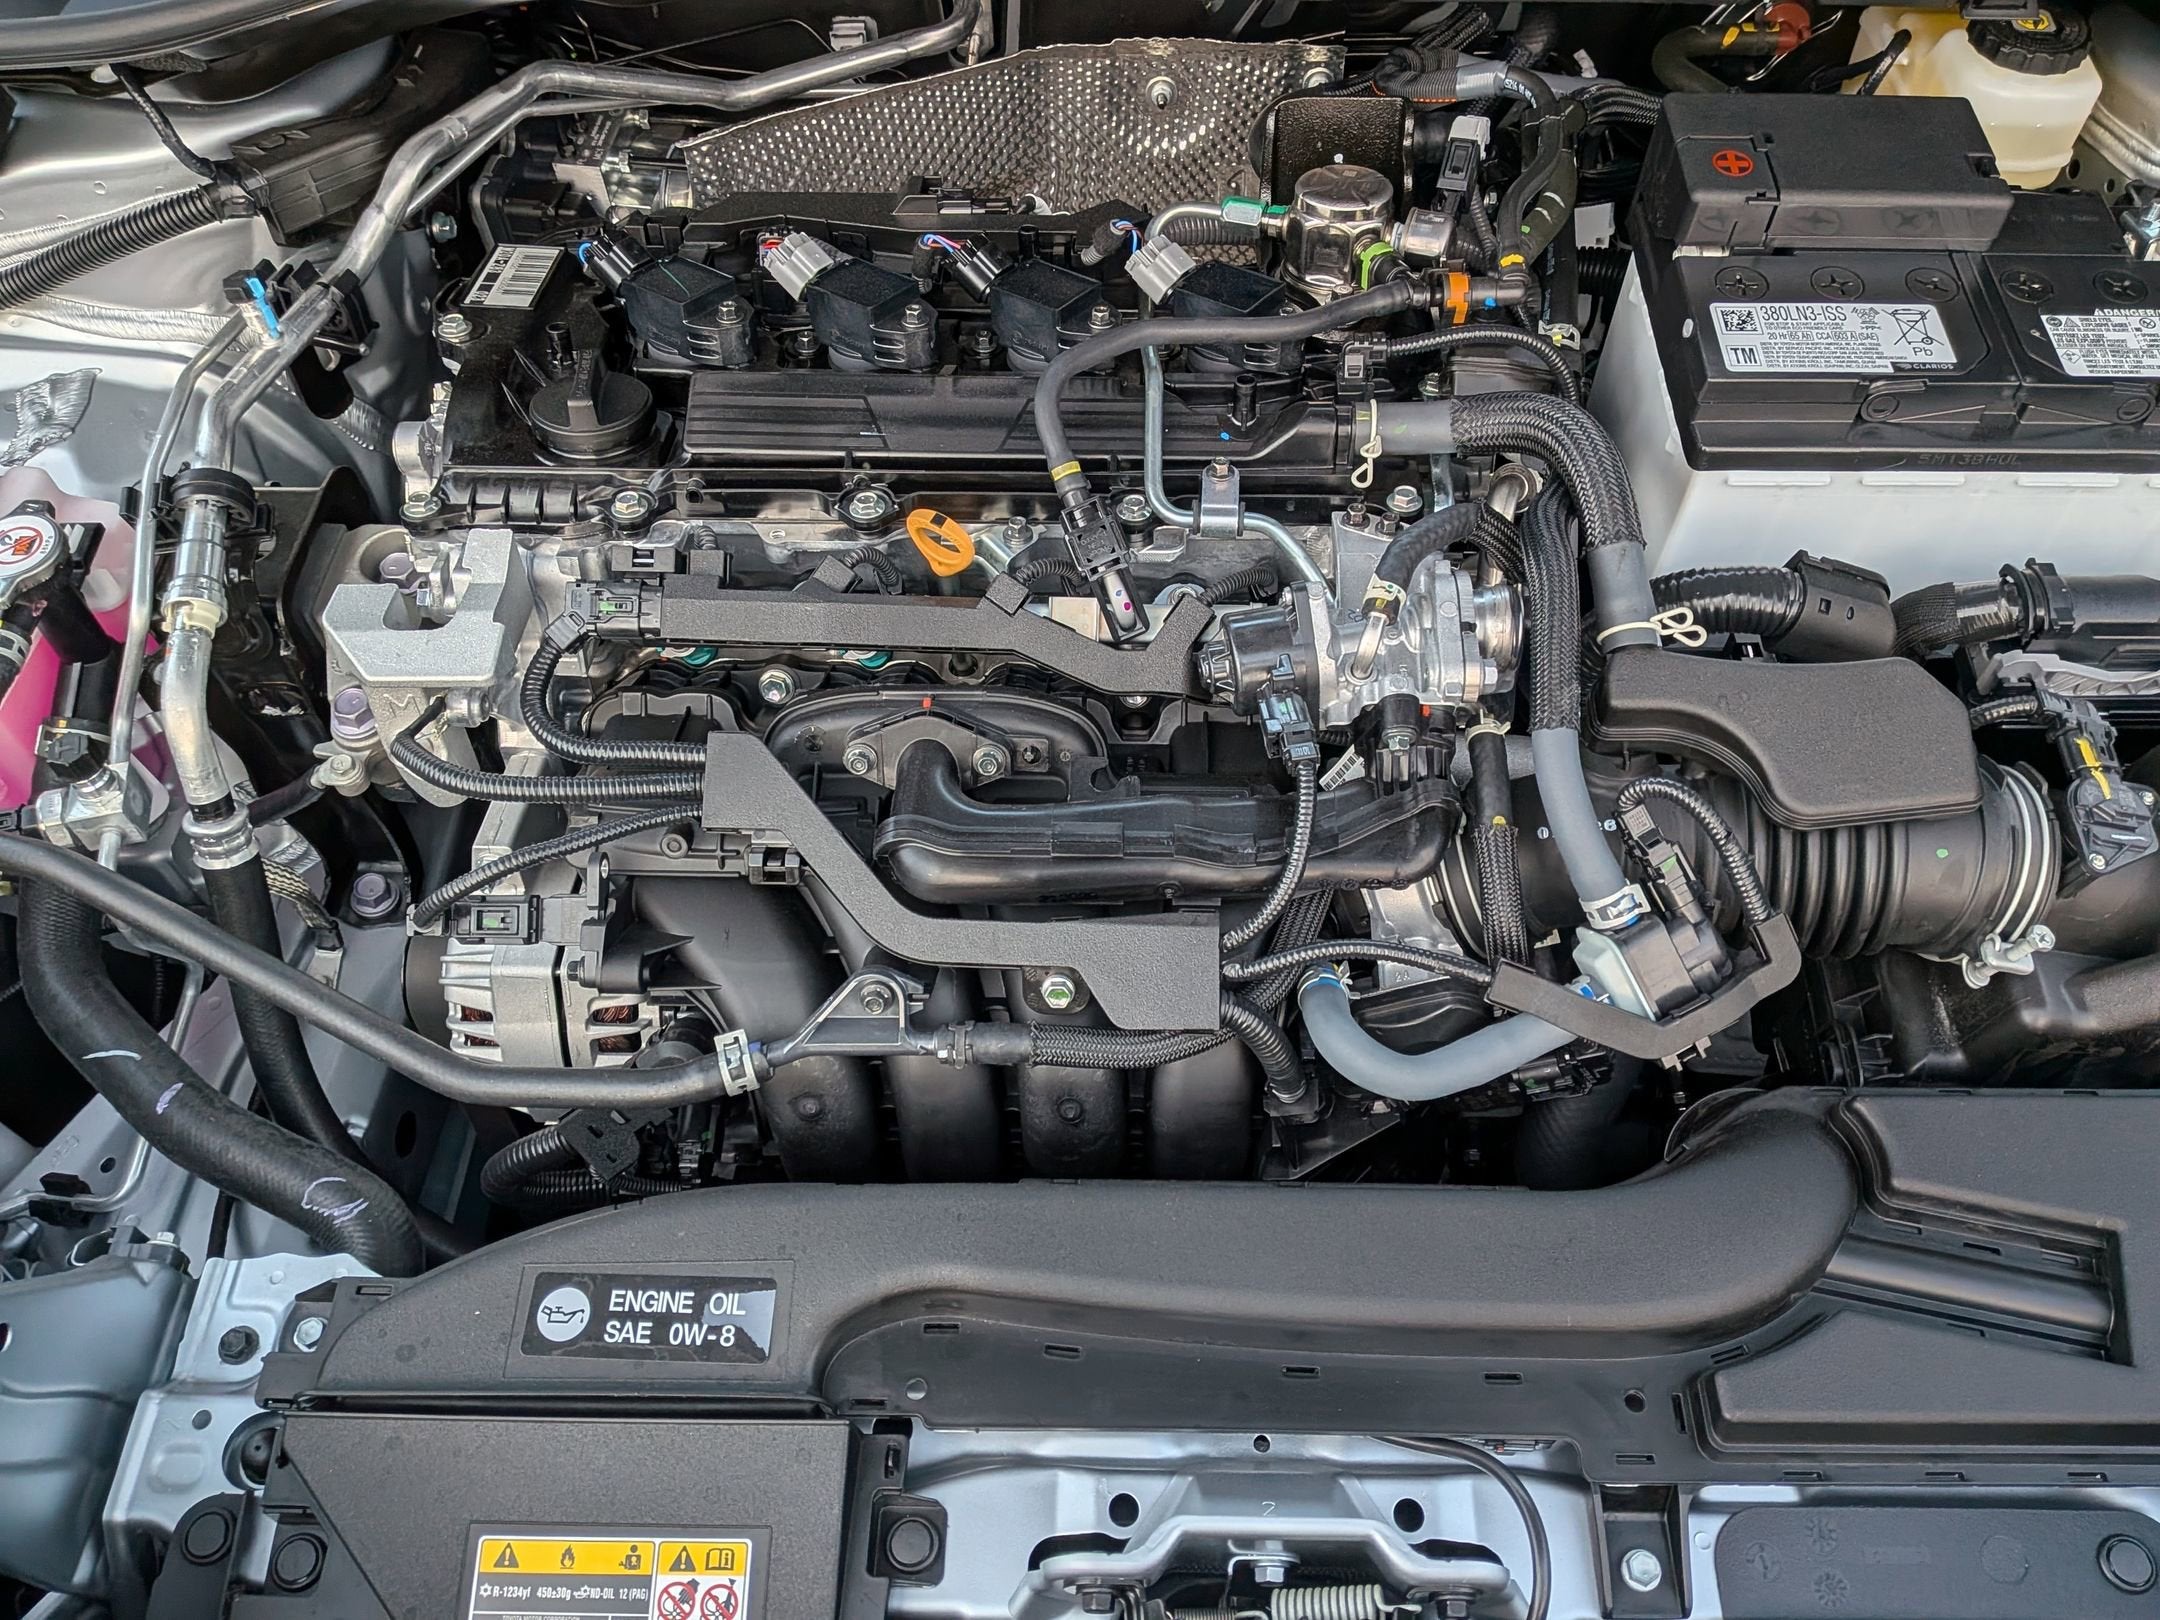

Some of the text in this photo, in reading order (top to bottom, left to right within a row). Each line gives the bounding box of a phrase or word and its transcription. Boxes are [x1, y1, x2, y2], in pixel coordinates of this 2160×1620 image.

[1760, 305, 1847, 321] 380LN3-ISS
[1768, 332, 1879, 342] 20 Hr 65 Ah CCA 603 A (SAE)
[1730, 347, 1758, 365] TM
[1912, 347, 1934, 357] Pb
[608, 1289, 747, 1316] ENGINE OIL
[603, 1321, 736, 1347] SAE 0W-8
[492, 1586, 649, 1602] R-1234yf 450±30g ND-OIL 12 (PAG)
